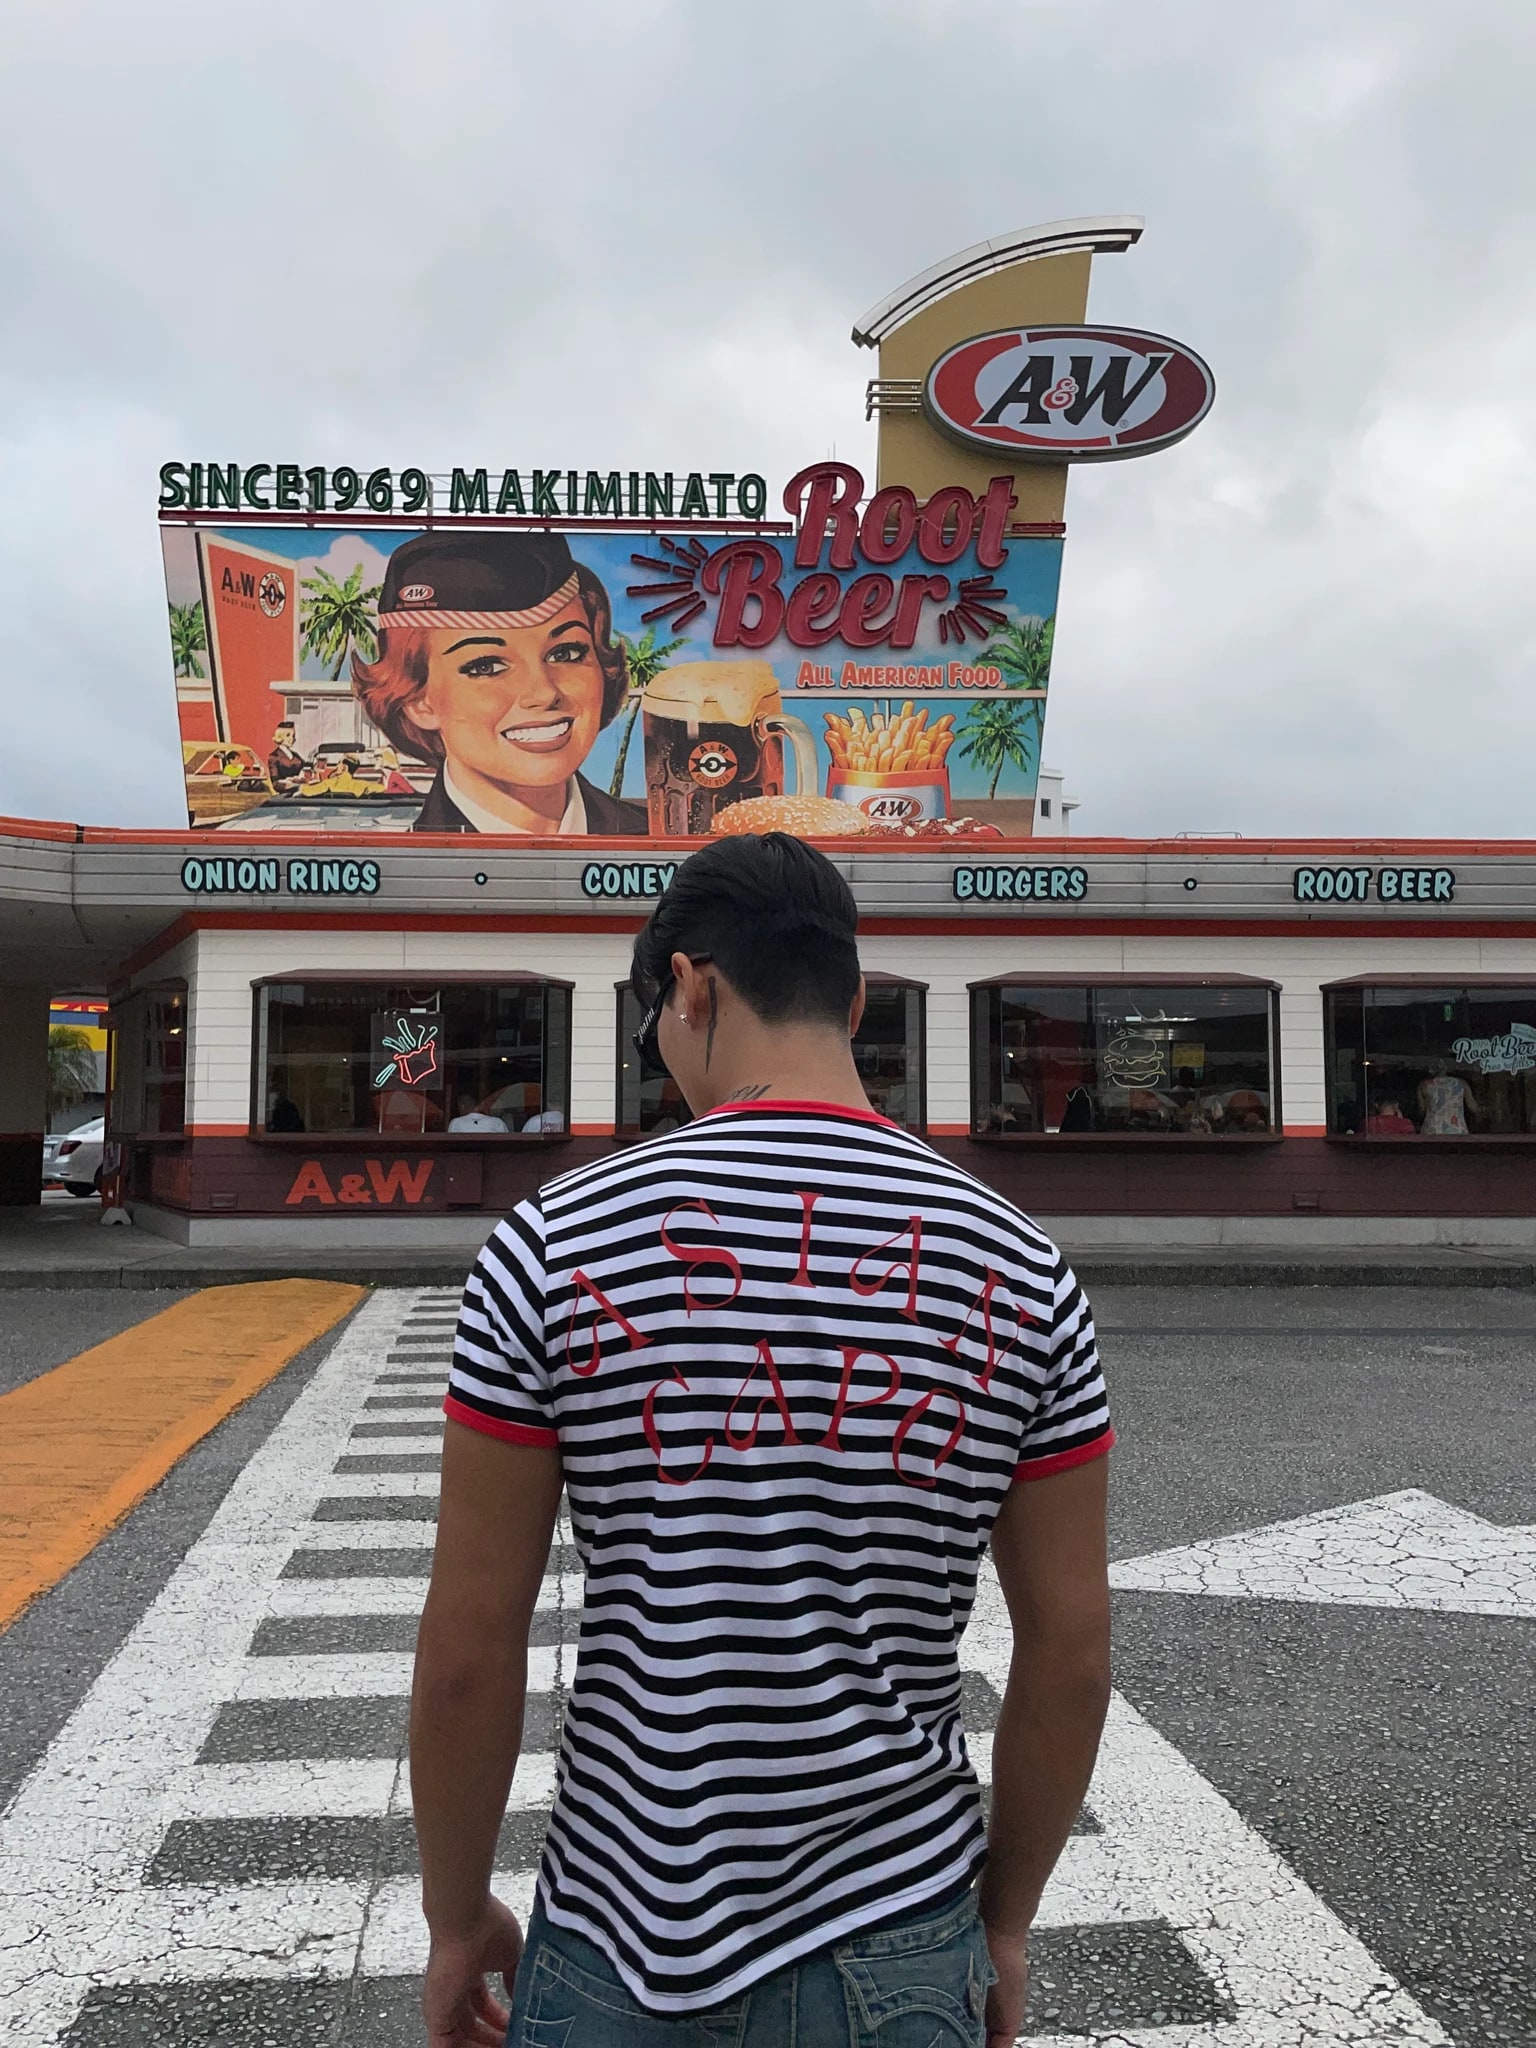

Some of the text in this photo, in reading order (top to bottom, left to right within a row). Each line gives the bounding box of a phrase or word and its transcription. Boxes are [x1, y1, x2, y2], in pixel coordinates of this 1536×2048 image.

[976, 354, 1173, 427] A&W
[450, 468, 767, 519] MAKIMINATO
[783, 461, 1018, 569] Root
[703, 540, 950, 649] Beer
[182, 858, 380, 894] ONION RINGS
[582, 863, 678, 897] CONEY
[954, 867, 1087, 899] BURGERS
[1296, 868, 1454, 901] ROOT BEER
[1453, 1034, 1536, 1063] Root Bee
[285, 1160, 434, 1204] A&W
[566, 1191, 1039, 1395] ASIAN
[642, 1338, 966, 1486] CAPO
